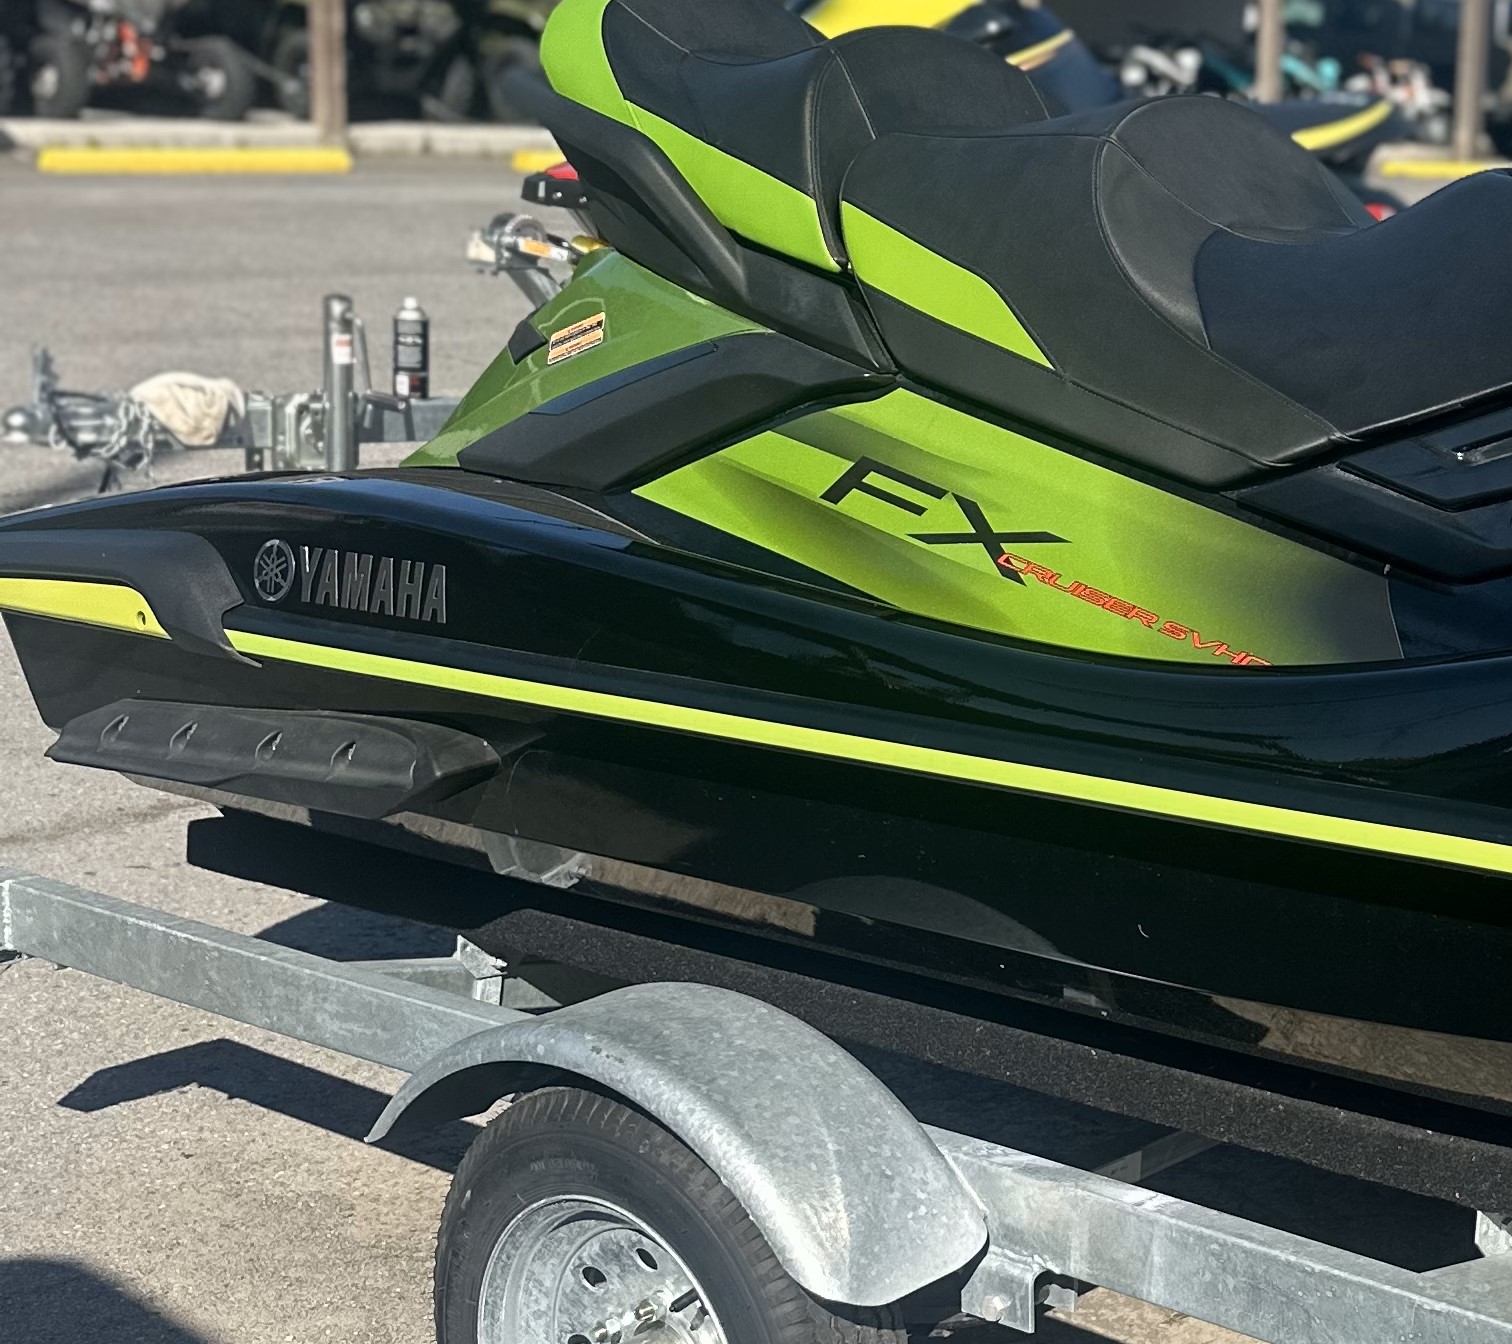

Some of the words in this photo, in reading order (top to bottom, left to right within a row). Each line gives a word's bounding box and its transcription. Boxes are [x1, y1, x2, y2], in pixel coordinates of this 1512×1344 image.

[818, 455, 1073, 587] FX
[300, 545, 447, 624] YAMAHA
[997, 552, 1160, 630] CRUISER
